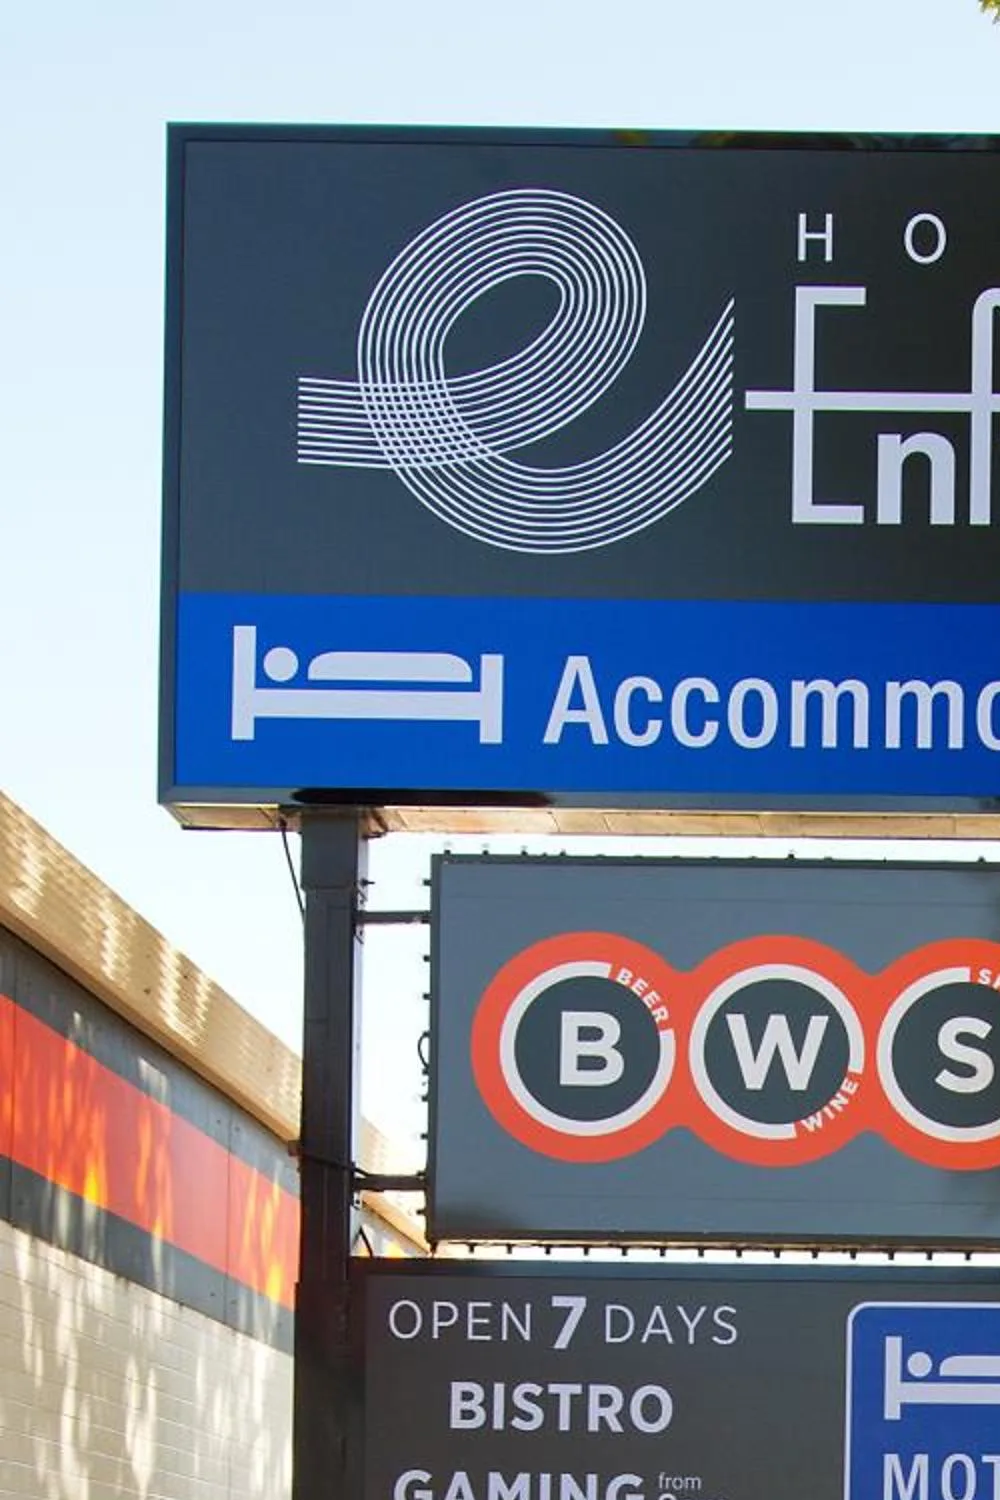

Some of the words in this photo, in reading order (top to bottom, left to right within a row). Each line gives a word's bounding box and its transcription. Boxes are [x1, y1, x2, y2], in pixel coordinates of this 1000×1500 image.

[615, 966, 671, 1028] BEER
[800, 1078, 860, 1134] WINE
[388, 1299, 532, 1341] OPEN
[550, 1295, 588, 1349] 7
[603, 1304, 739, 1346] DAYS
[449, 1380, 674, 1434] BISTRO
[657, 1471, 702, 1491] from
